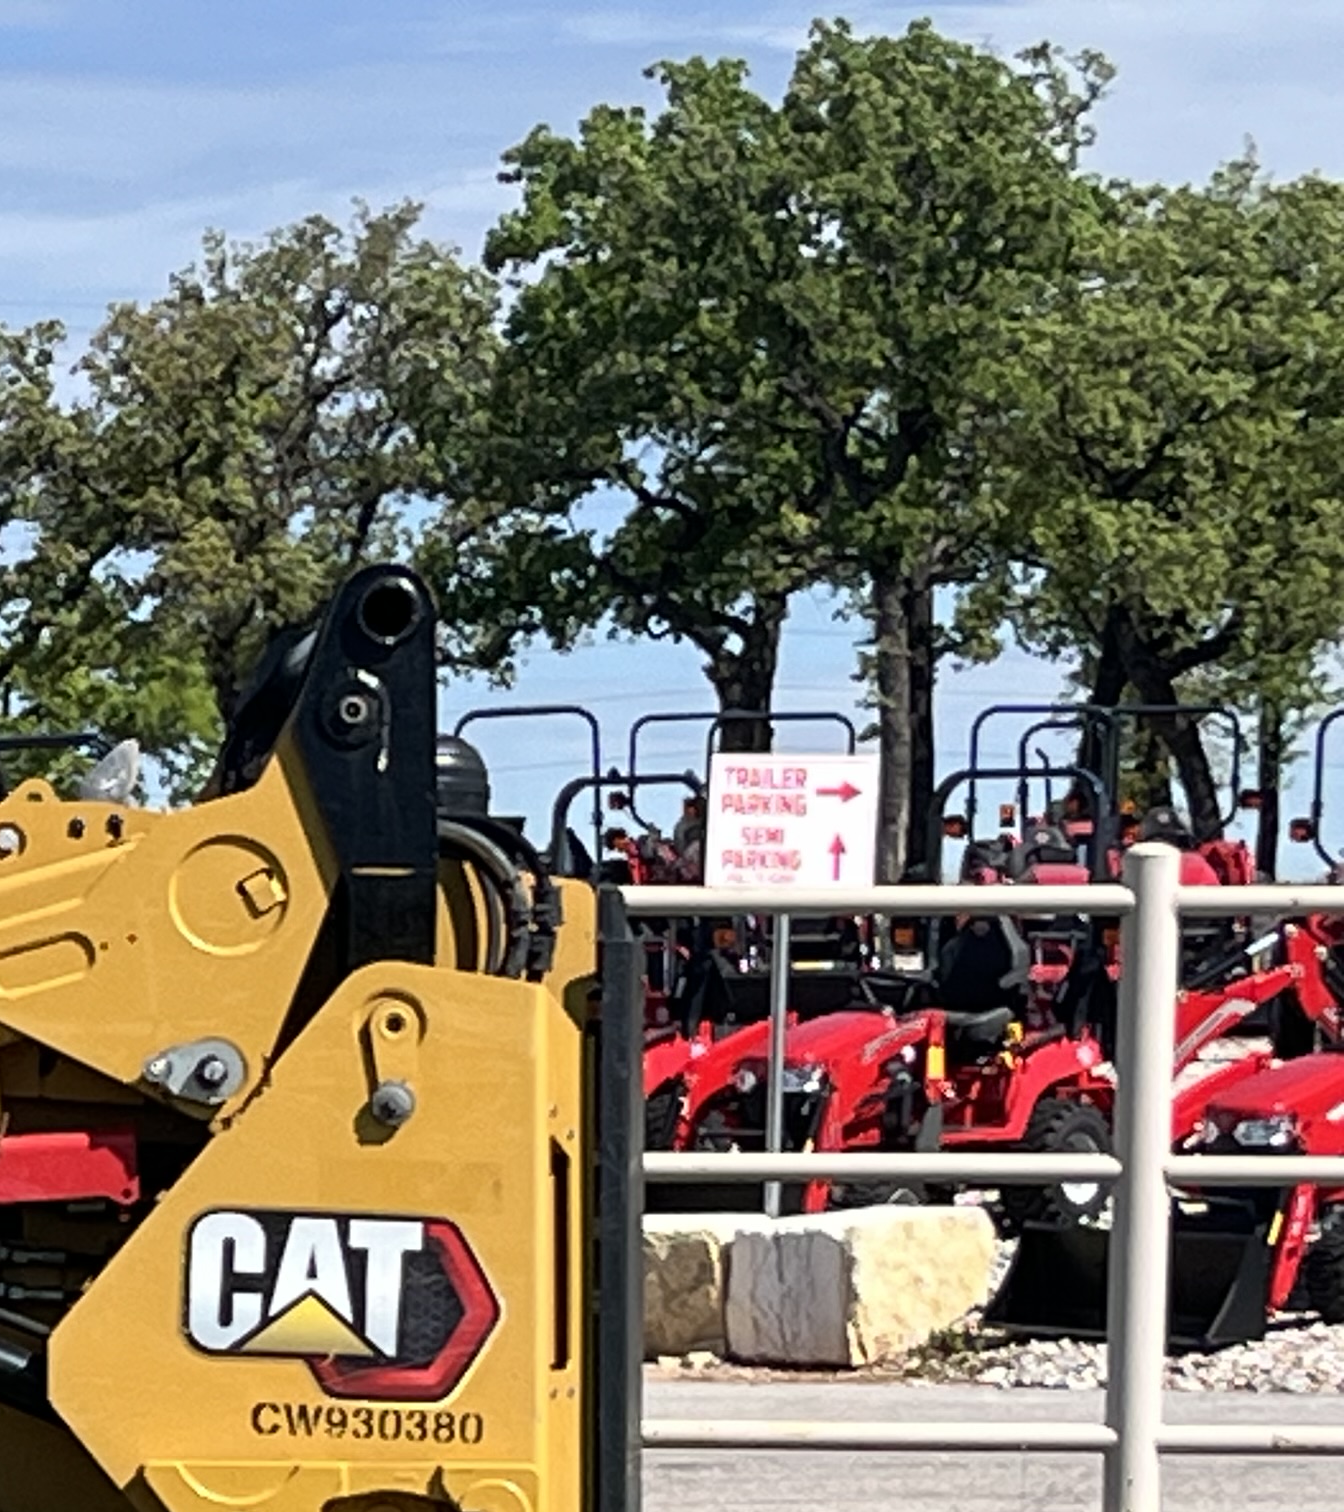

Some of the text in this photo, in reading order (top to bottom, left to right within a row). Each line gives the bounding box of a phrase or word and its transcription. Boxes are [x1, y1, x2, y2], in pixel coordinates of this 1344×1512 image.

[724, 766, 807, 789] TRAILER
[721, 793, 807, 817] PARKING
[740, 826, 785, 846] SEMI
[721, 849, 802, 871] PARKING
[188, 1211, 424, 1358] CAT
[250, 1402, 484, 1444] CW930380
